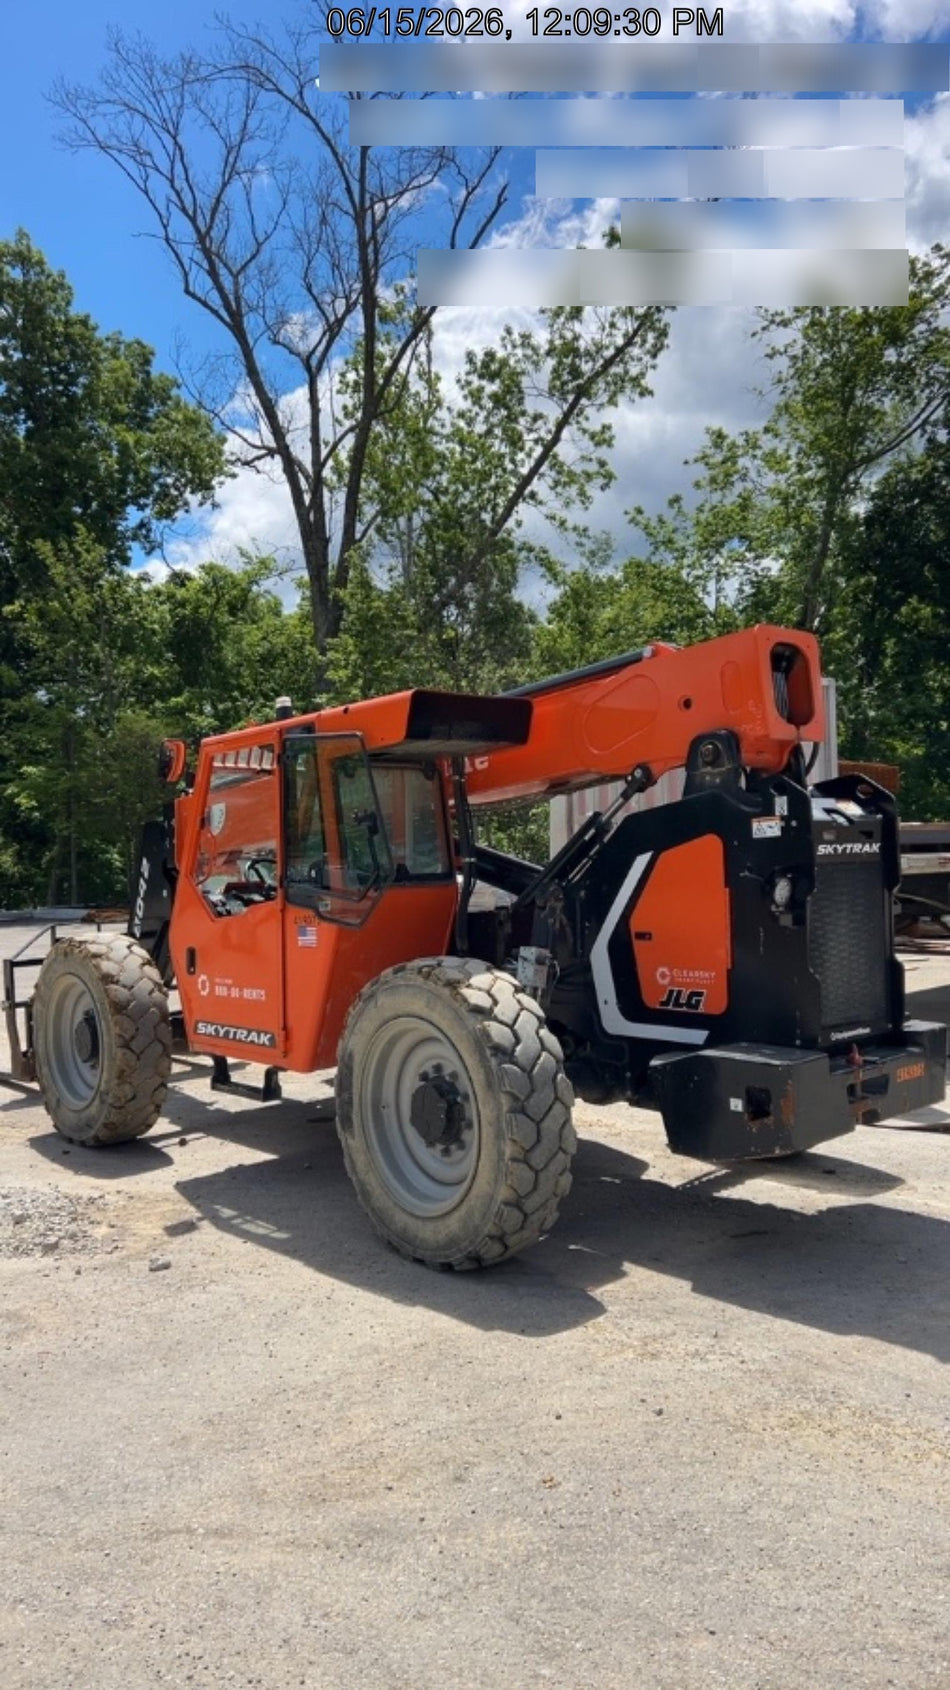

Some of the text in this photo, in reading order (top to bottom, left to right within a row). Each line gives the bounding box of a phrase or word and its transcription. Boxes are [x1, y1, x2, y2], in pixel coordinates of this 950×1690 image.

[816, 843, 881, 855] SKYTRAK
[672, 969, 716, 978] CLEARSKY
[657, 988, 706, 1011] JLG
[196, 1022, 272, 1046] SKYTRAK
